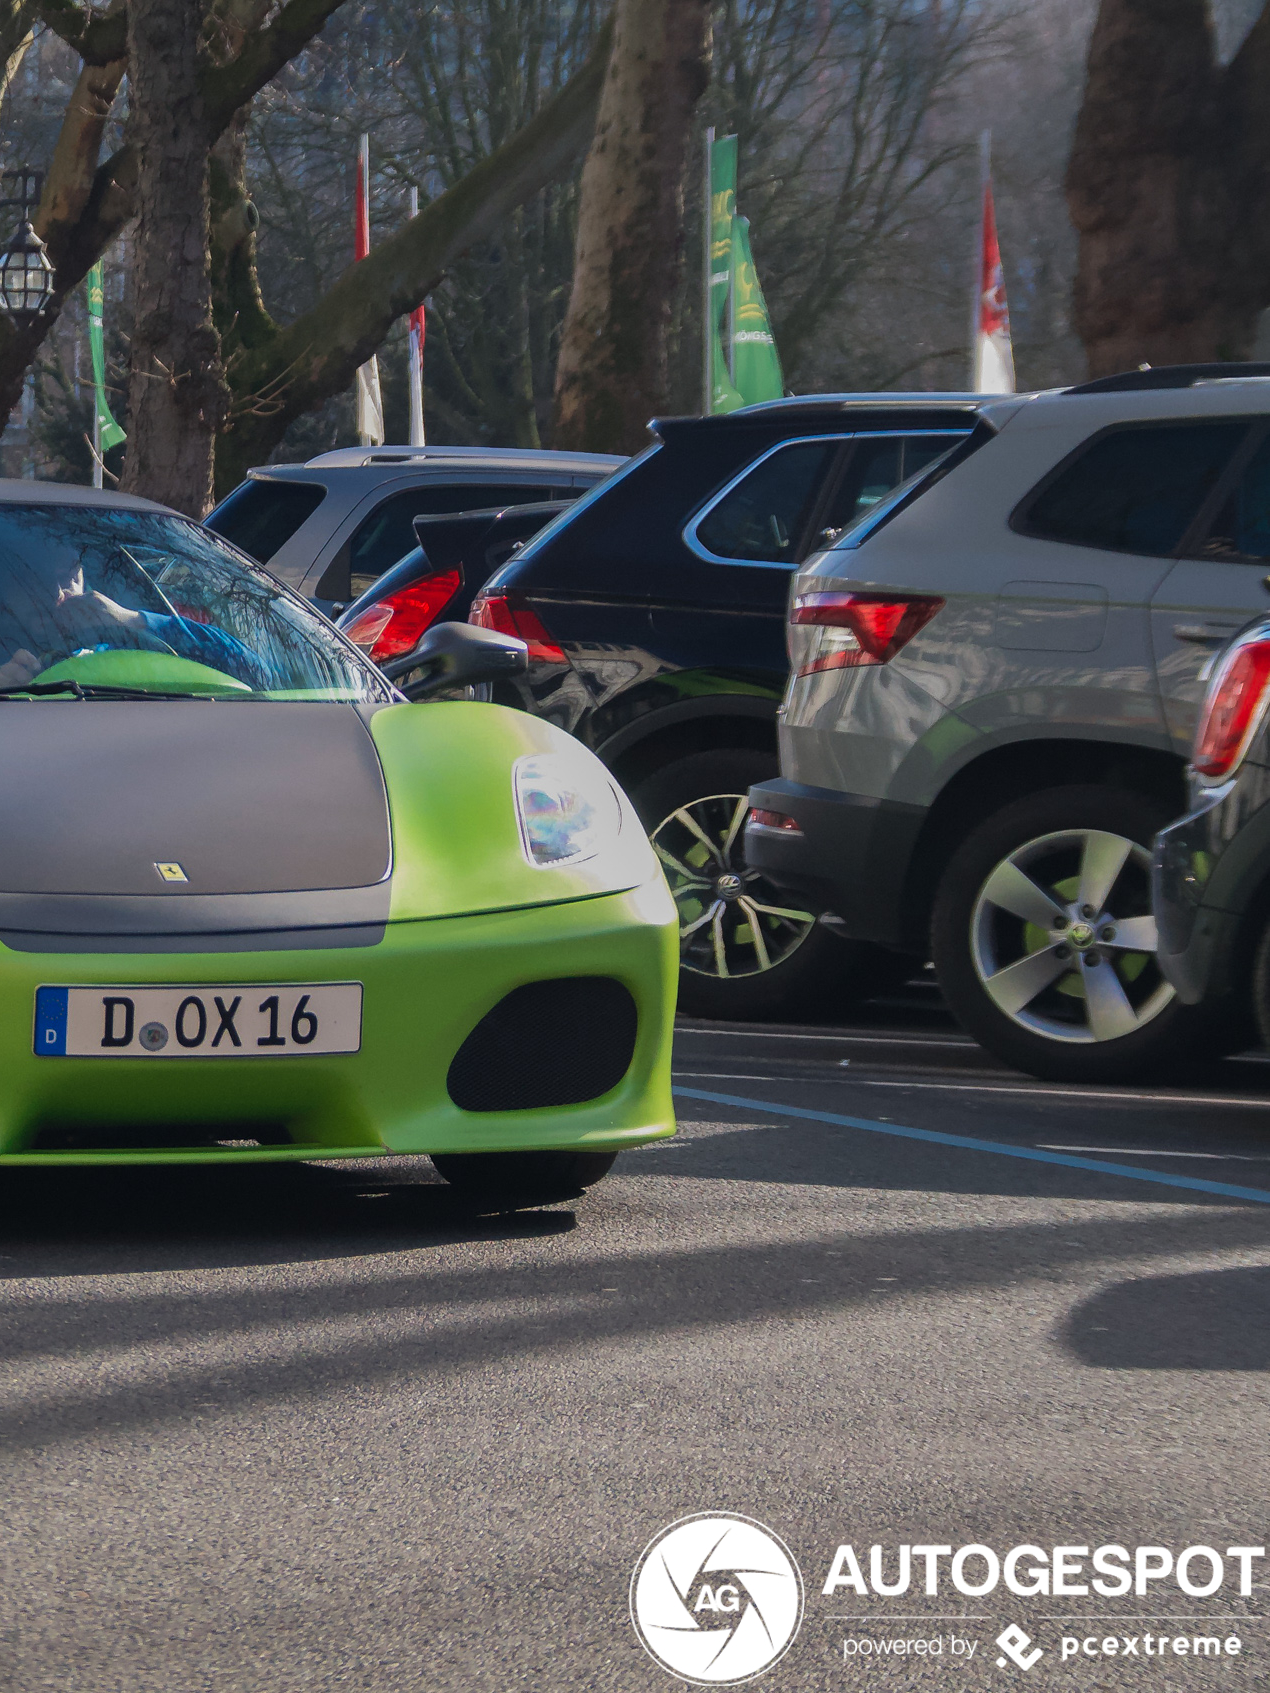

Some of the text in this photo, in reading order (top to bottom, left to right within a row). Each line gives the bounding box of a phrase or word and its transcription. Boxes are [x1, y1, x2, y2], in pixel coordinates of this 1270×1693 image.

[45, 994, 318, 1048] D D OX 16
